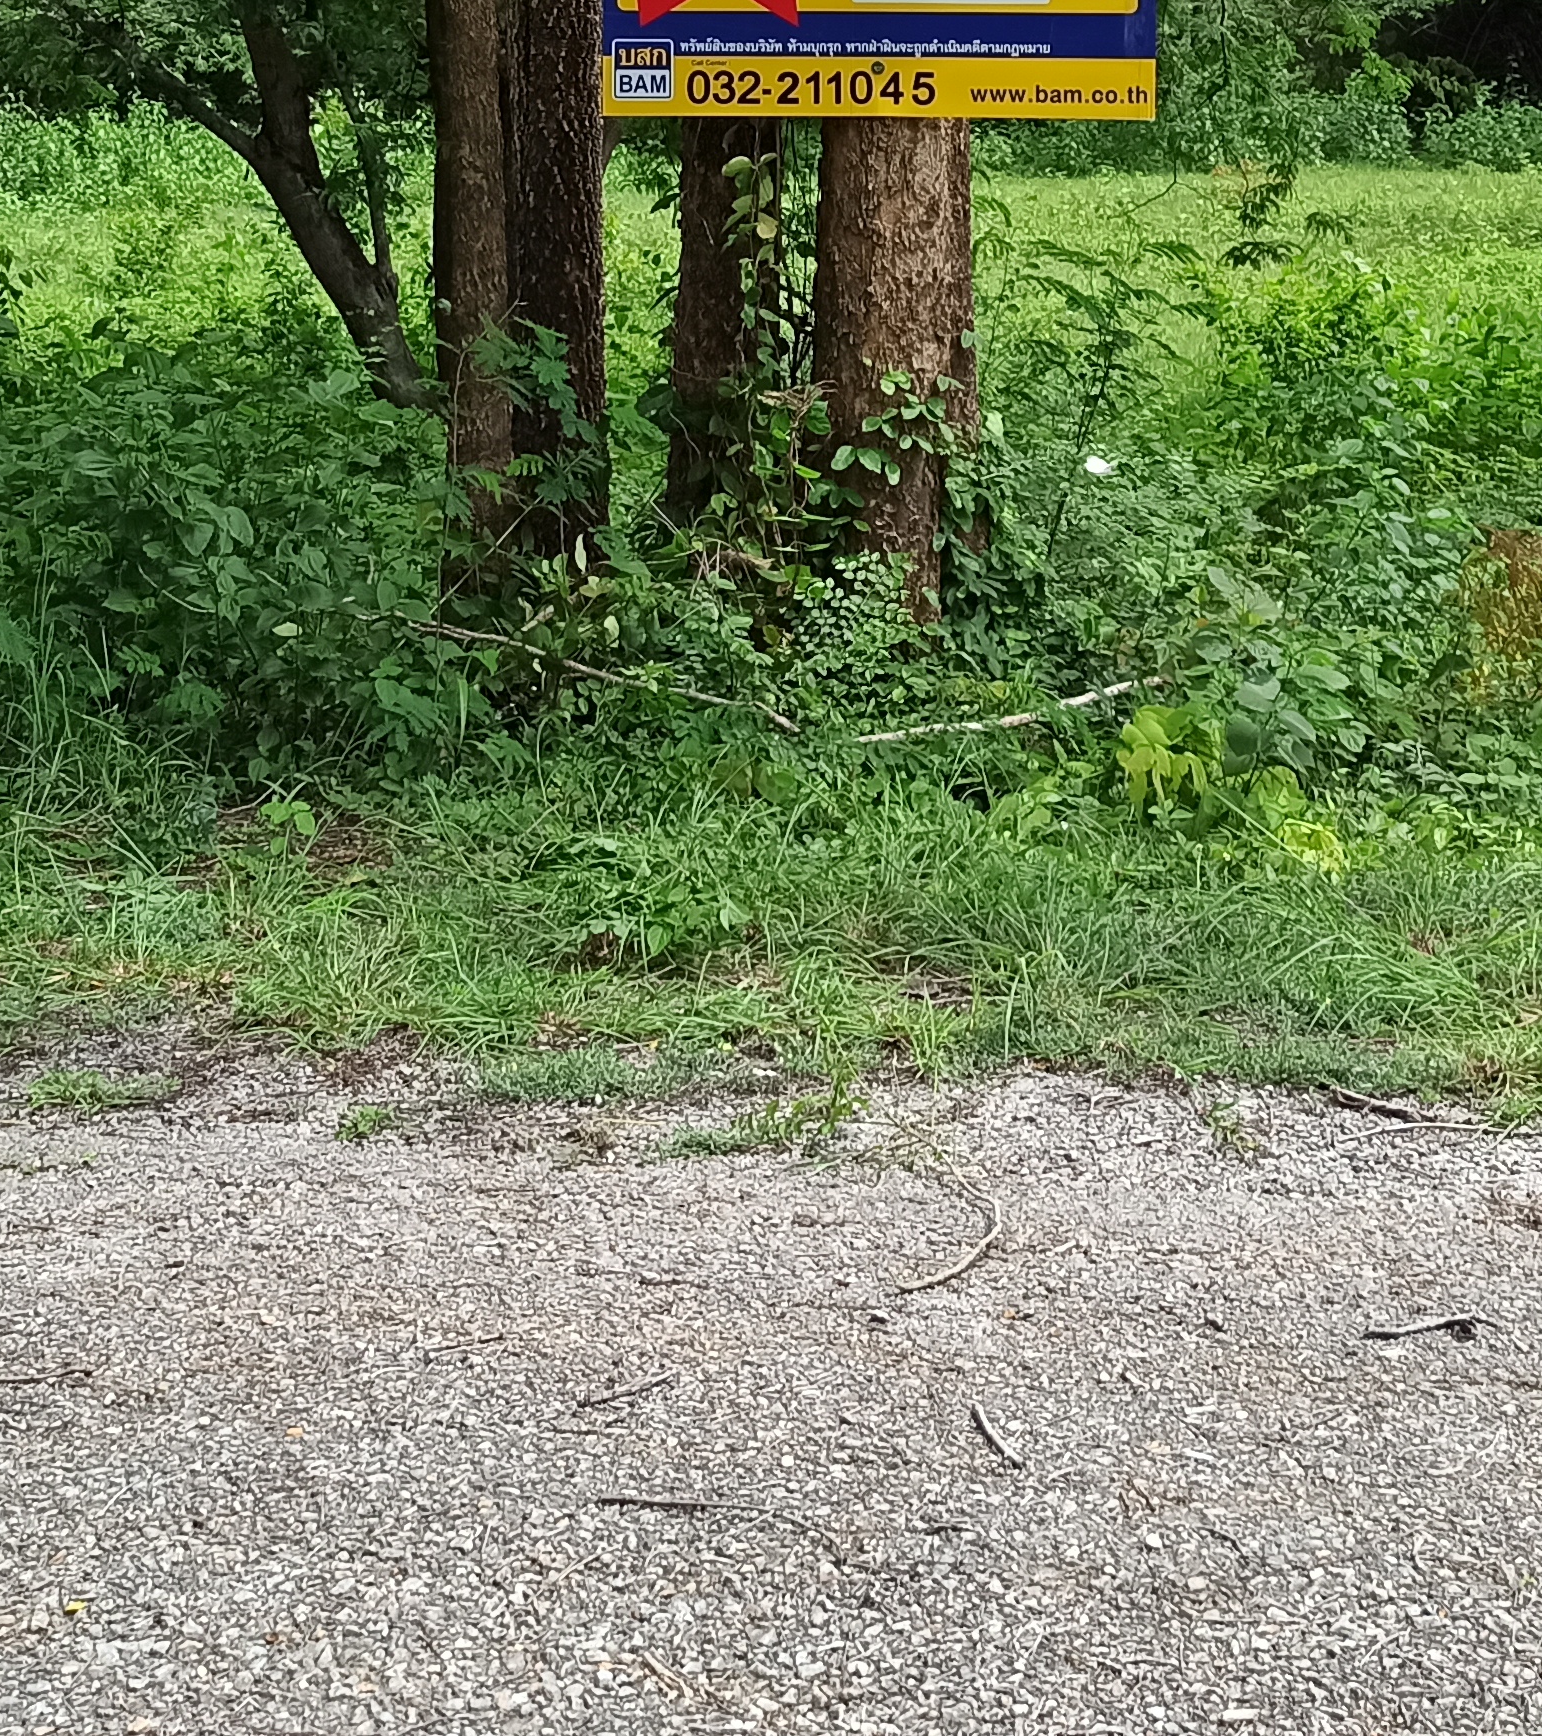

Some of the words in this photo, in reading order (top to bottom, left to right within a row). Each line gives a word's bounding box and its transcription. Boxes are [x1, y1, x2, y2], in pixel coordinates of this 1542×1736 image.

[618, 47, 668, 66] บสก
[680, 38, 782, 54] ทรัพย์สินของบริษัท
[788, 38, 842, 57] ห้ามบุกรุก
[619, 74, 668, 94] BAM
[687, 69, 936, 105] 032-211045
[970, 82, 1149, 105] www.bam.co.th
